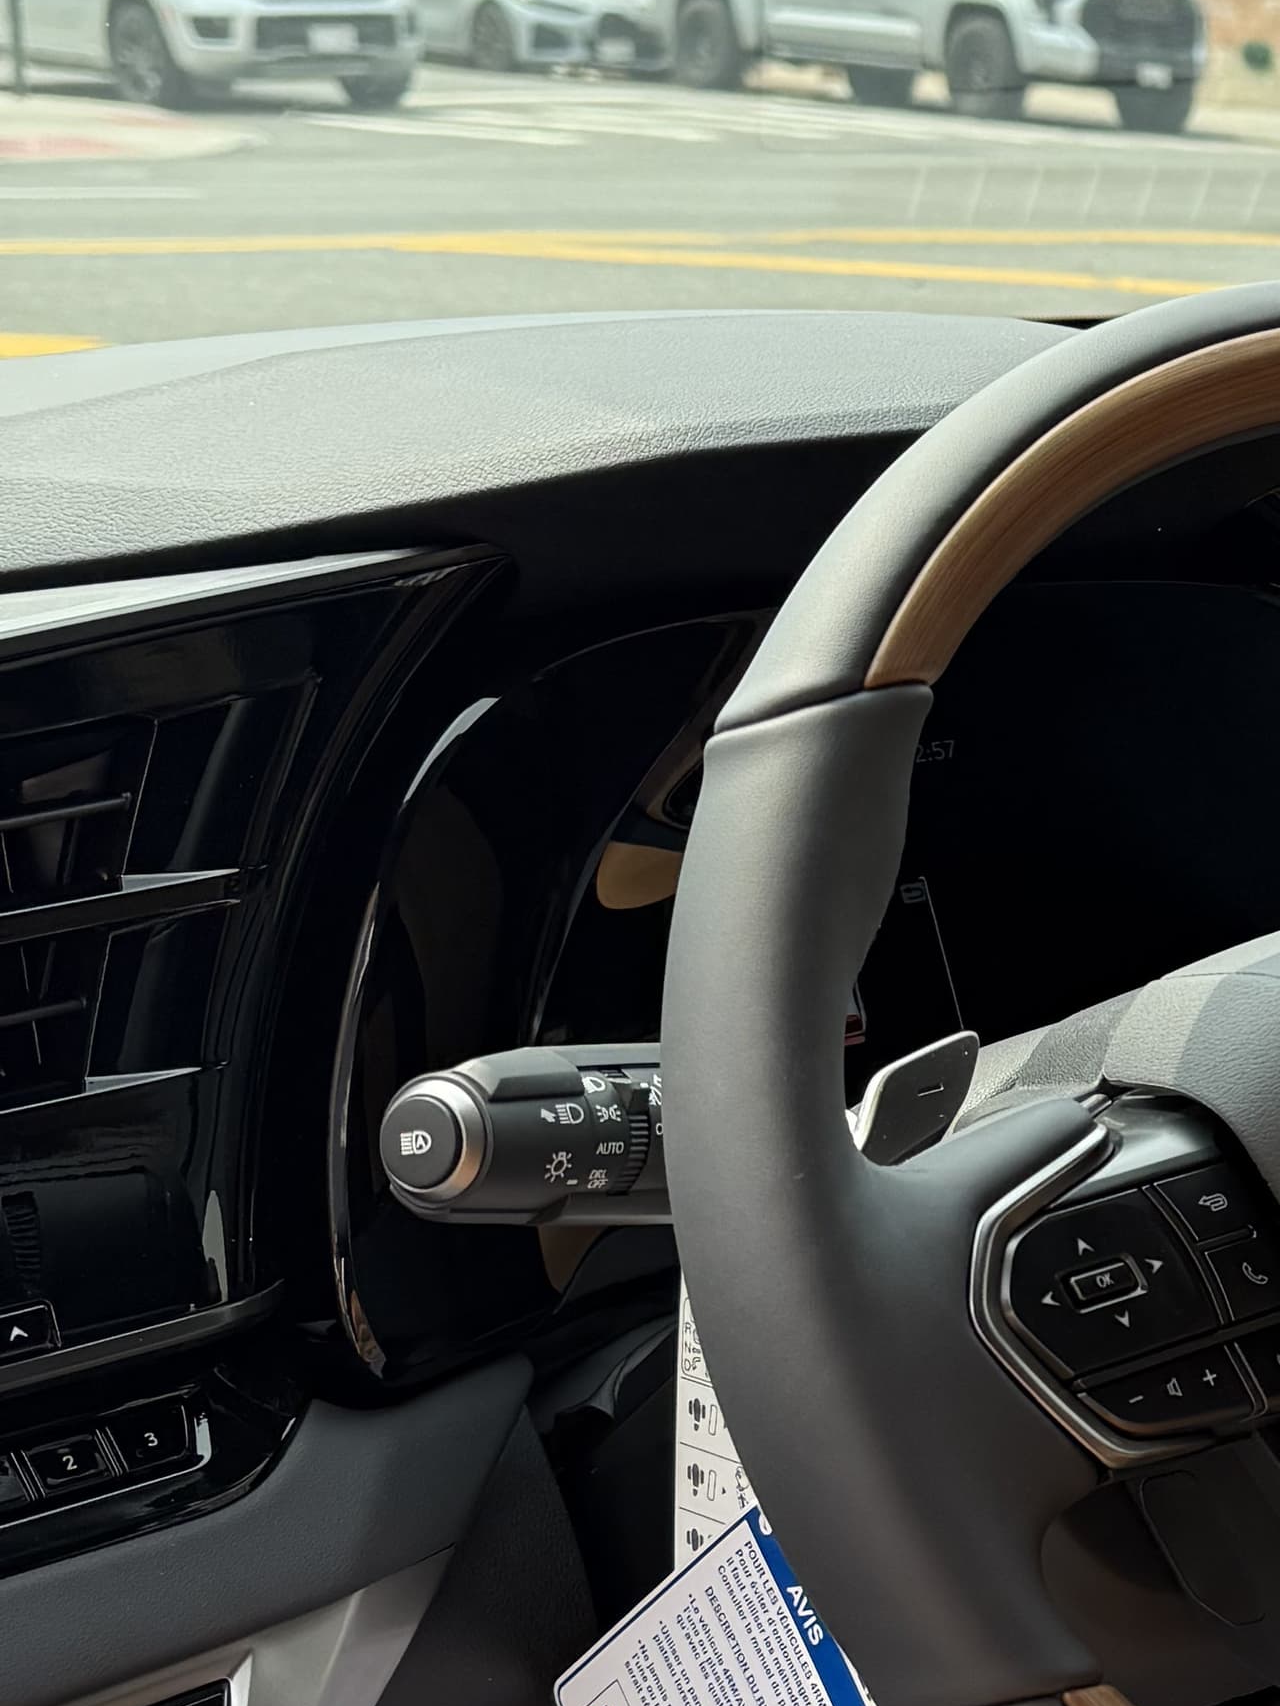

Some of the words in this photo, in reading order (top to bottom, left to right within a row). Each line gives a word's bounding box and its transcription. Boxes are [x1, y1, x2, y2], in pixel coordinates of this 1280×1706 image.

[596, 1142, 624, 1155] AUTO
[1096, 1272, 1115, 1289] OK
[143, 1431, 159, 1447] 3
[62, 1454, 78, 1471] 2
[786, 1584, 825, 1646] AVIS
